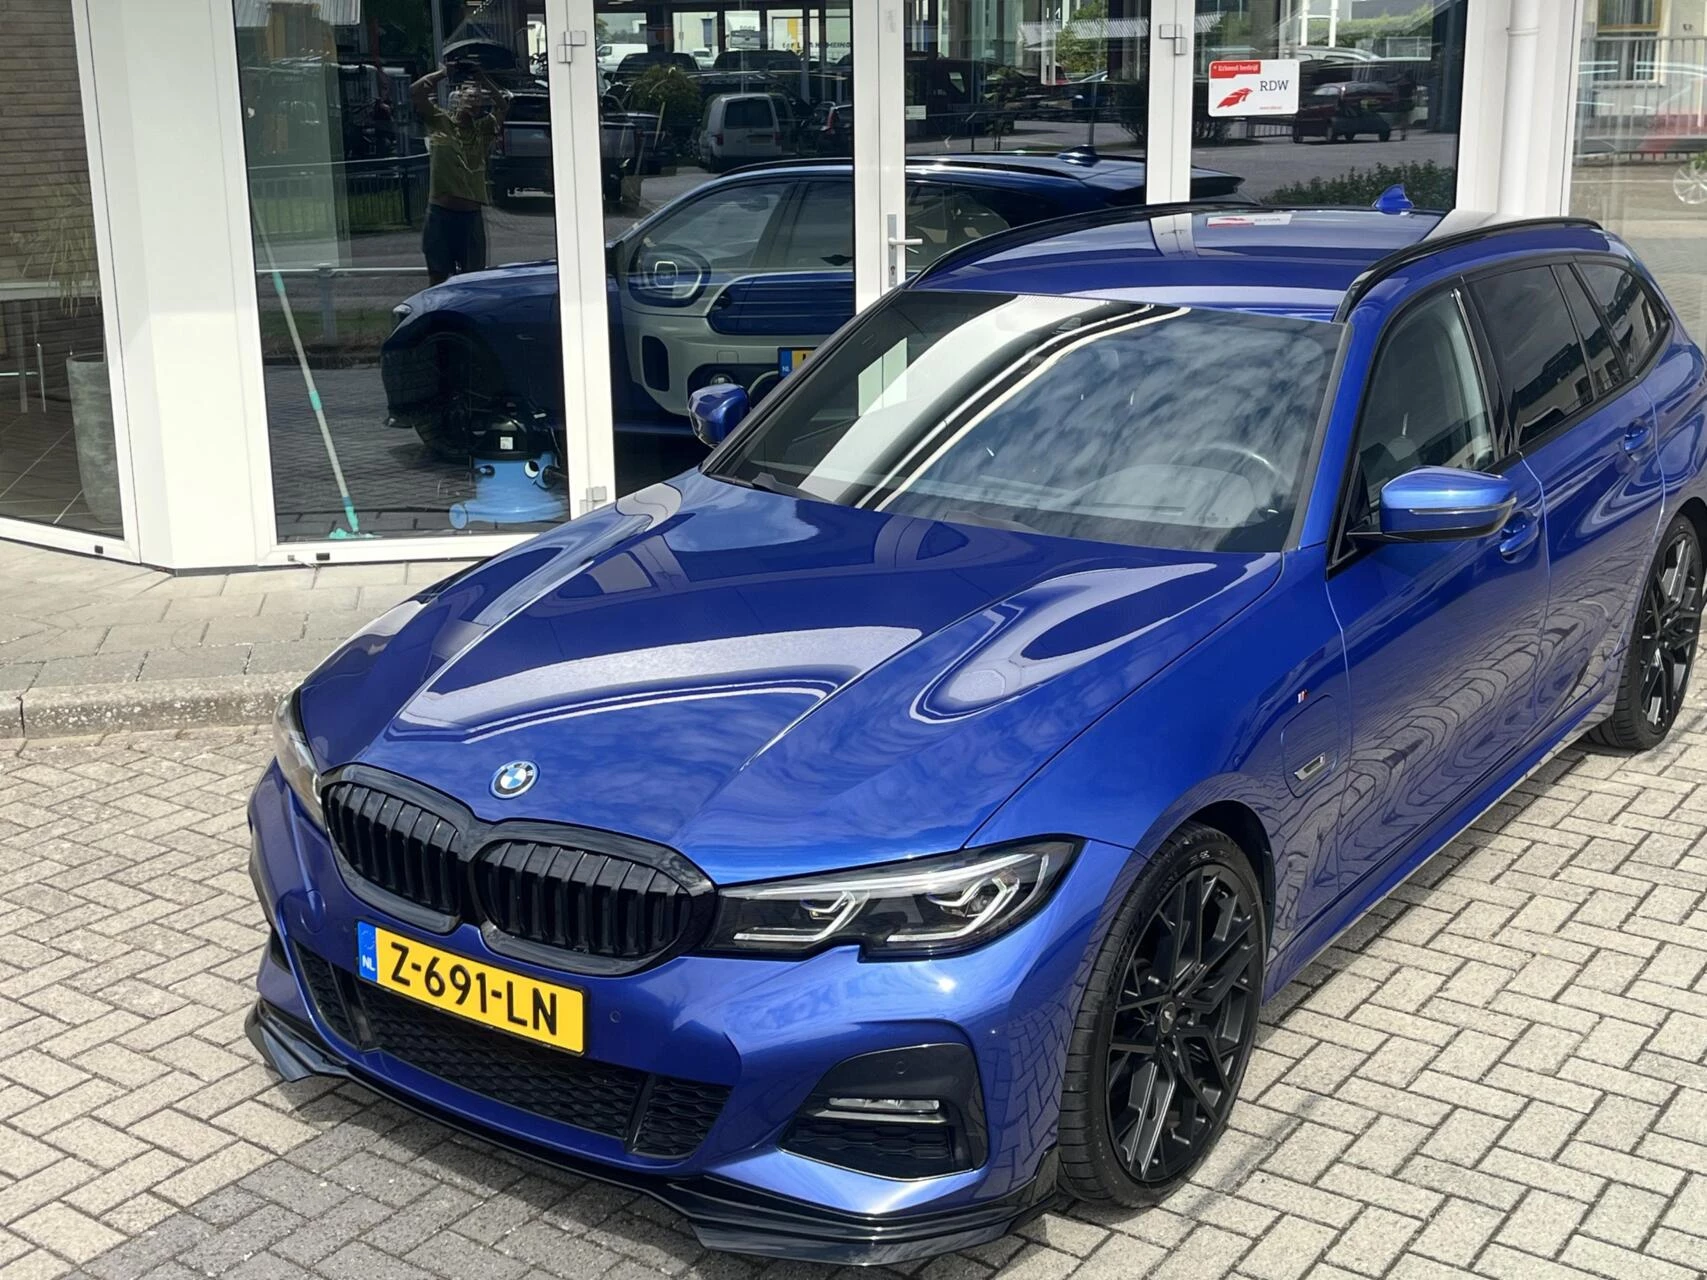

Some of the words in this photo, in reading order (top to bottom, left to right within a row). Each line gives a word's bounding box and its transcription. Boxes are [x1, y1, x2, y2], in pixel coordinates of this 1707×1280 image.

[1260, 80, 1289, 92] RDW
[362, 954, 376, 972] NL
[391, 941, 557, 1036] Z-691-LN
